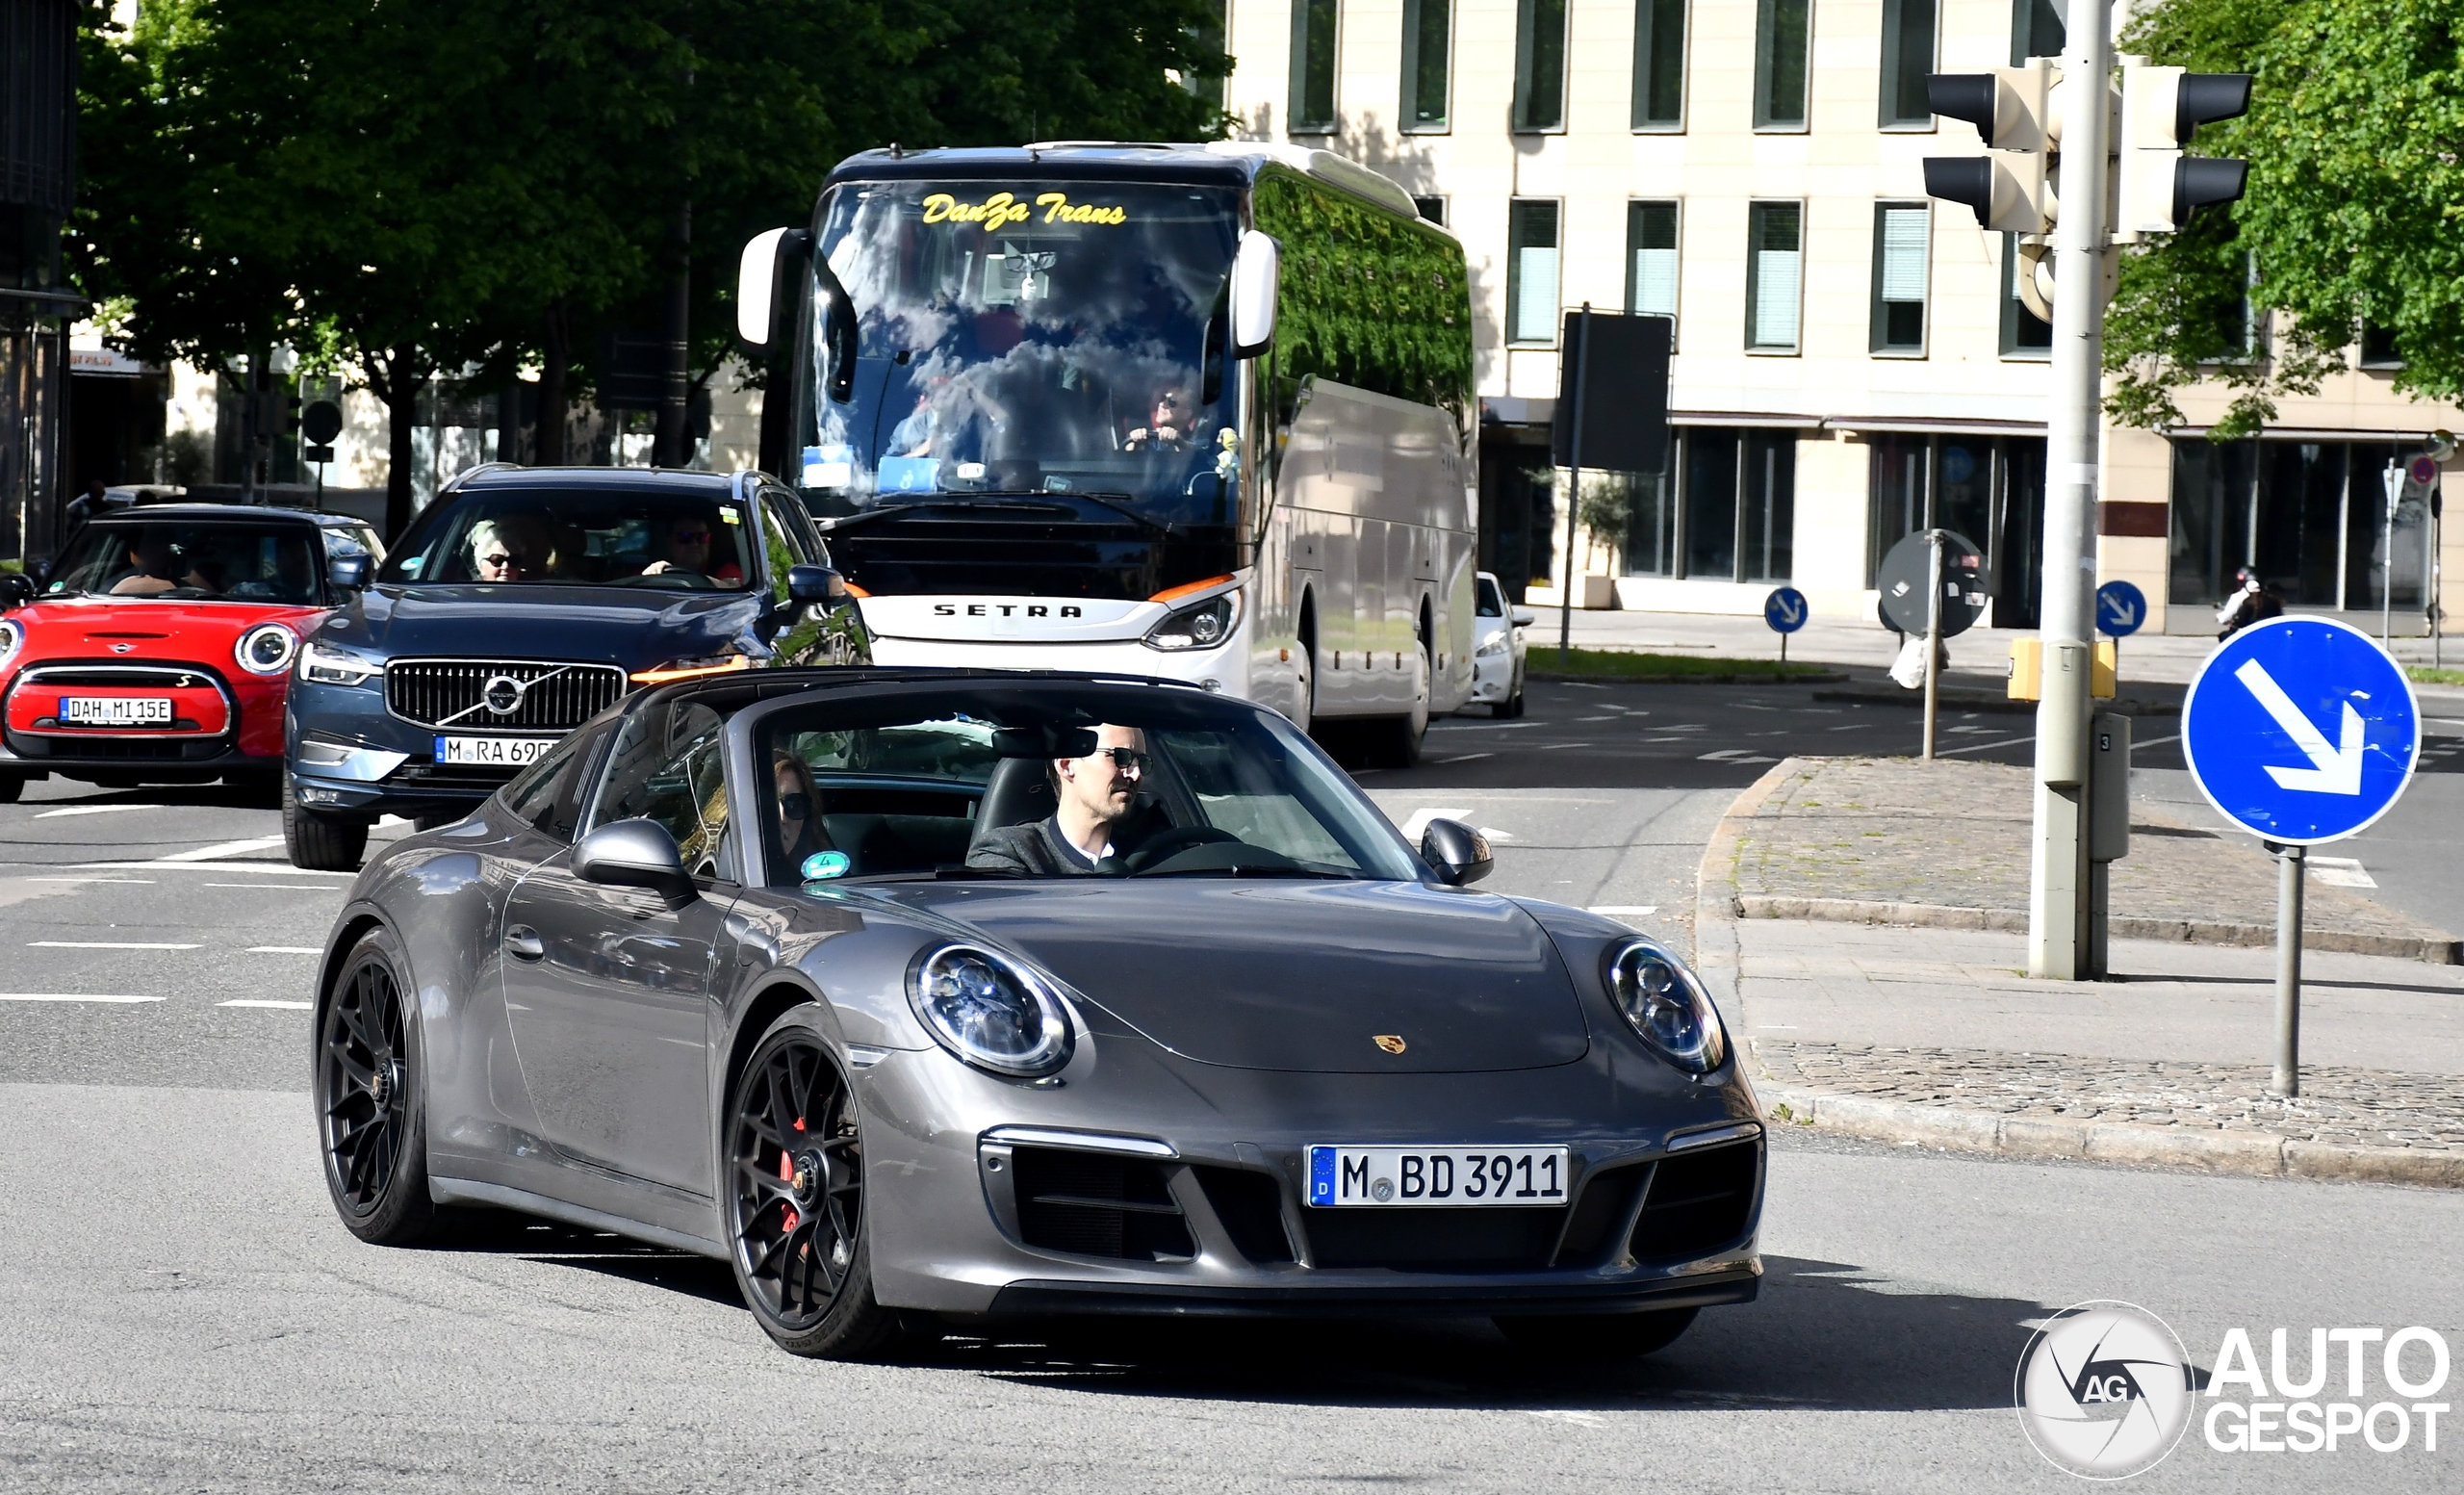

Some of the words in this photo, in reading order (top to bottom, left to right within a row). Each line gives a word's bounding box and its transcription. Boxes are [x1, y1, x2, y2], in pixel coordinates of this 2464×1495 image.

[922, 192, 1030, 232] DanZa
[1036, 193, 1126, 224] Trans
[934, 605, 1082, 618] SETRA
[175, 675, 192, 687] S
[71, 701, 101, 718] DAH
[114, 702, 131, 718] MI
[137, 702, 168, 718] 15E
[2101, 735, 2109, 750] 3
[449, 740, 461, 760] M
[476, 741, 503, 761] RA
[820, 856, 831, 866] 4
[1343, 1155, 1368, 1198] M
[1400, 1155, 1453, 1198] BD
[1464, 1155, 1563, 1198] 3911
[1318, 1183, 1328, 1196] D
